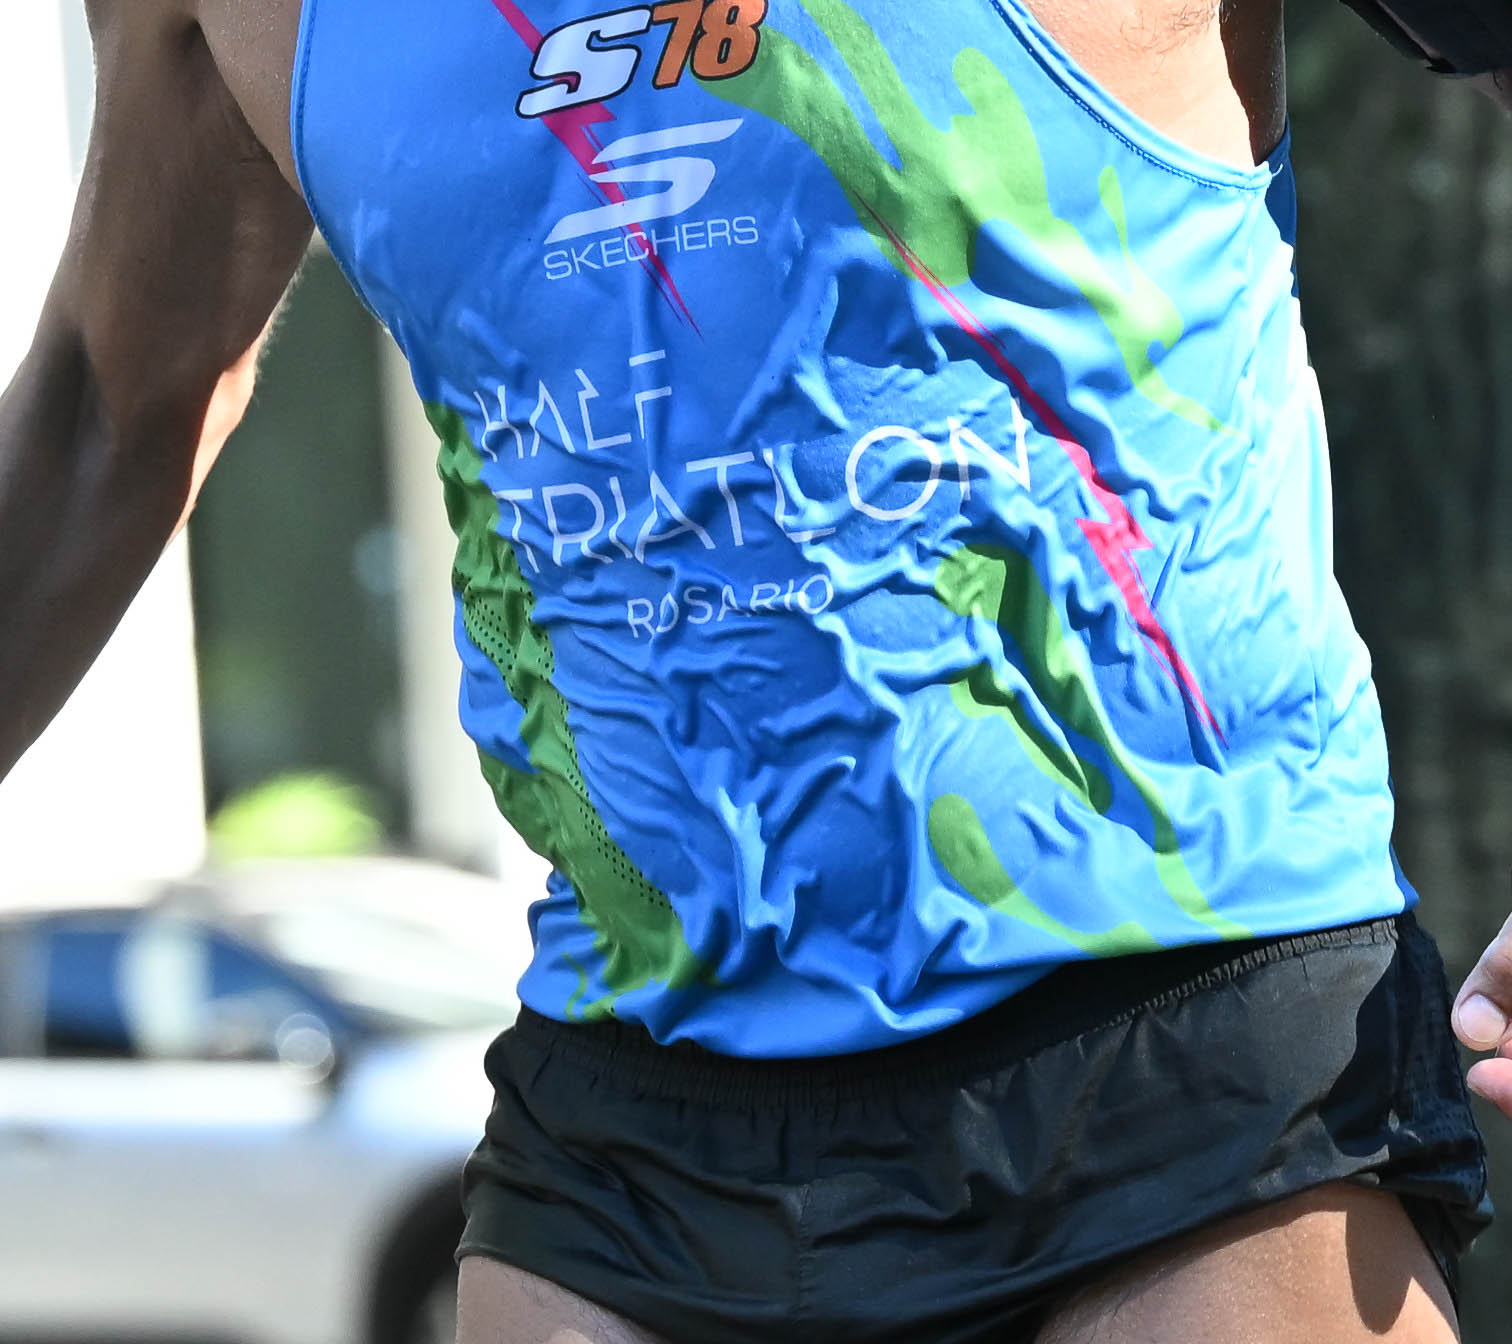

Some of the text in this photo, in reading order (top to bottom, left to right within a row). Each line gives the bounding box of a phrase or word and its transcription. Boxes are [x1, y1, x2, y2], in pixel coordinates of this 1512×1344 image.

[542, 215, 760, 281] SKECHERS
[491, 397, 1032, 575] TRIATLON
[626, 572, 835, 646] ROSARIO
